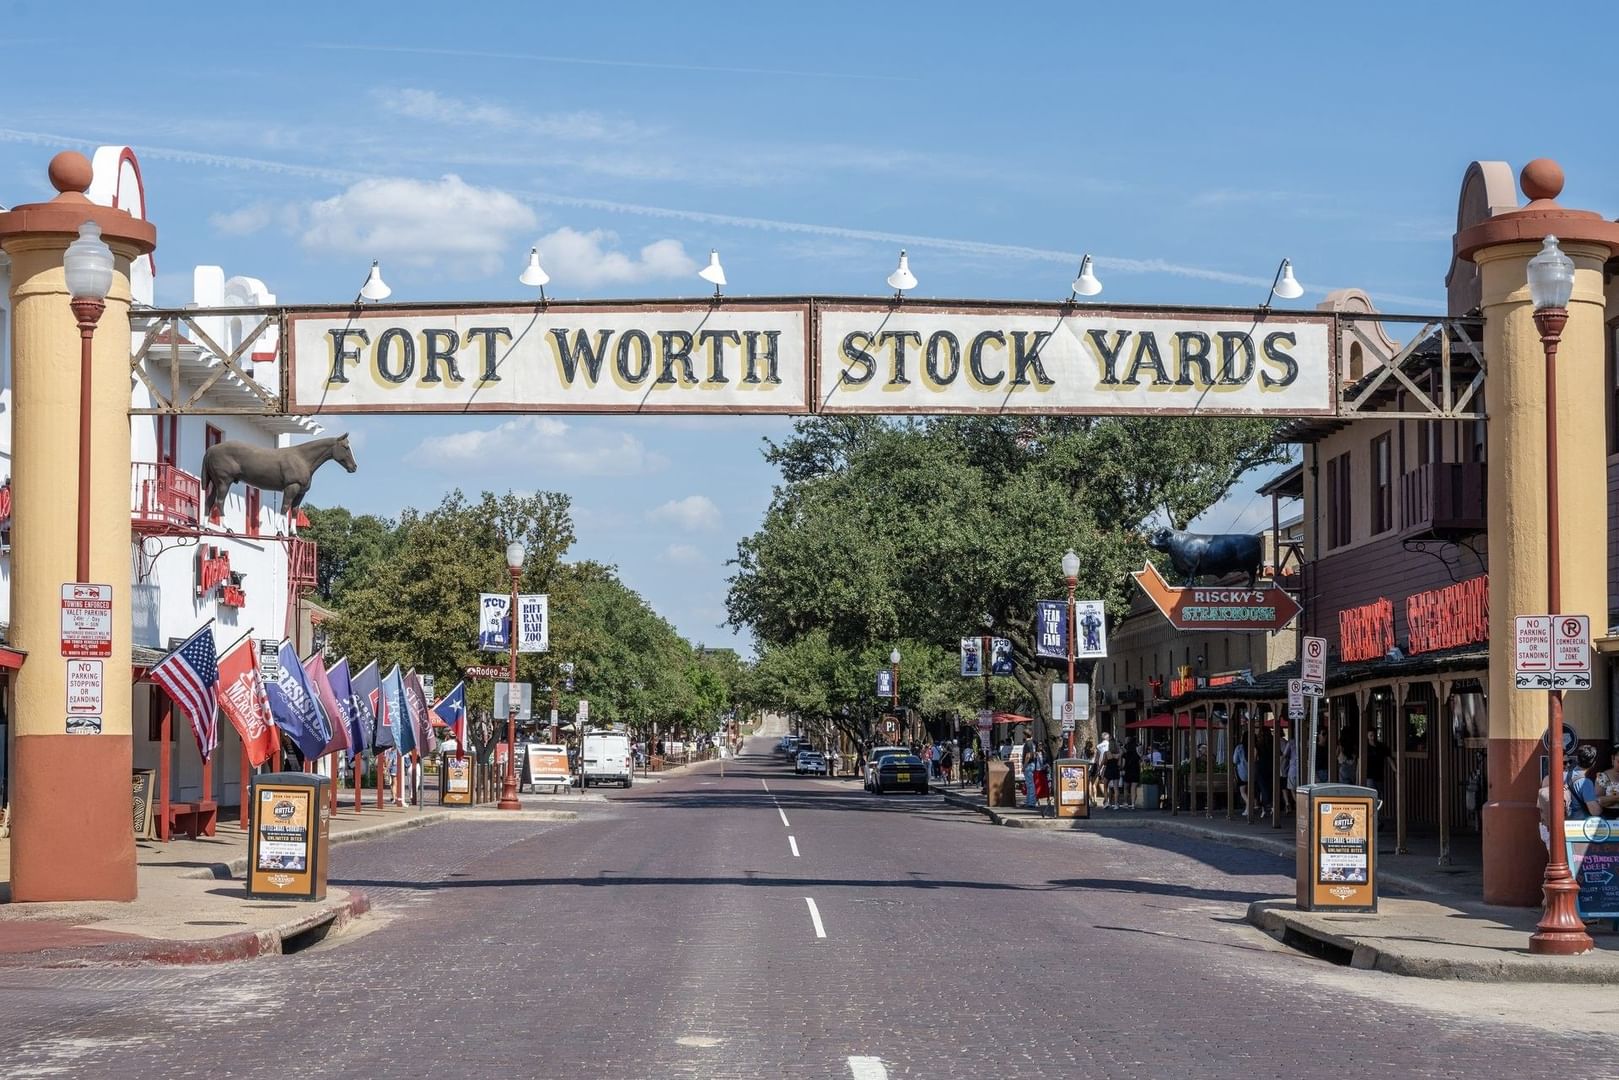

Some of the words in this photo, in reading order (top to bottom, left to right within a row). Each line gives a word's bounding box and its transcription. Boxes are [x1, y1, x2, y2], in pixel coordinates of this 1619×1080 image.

[325, 327, 513, 390] FORT
[547, 328, 783, 391] WORTH
[839, 329, 1056, 392] STOCK
[1086, 329, 1299, 392] YARDS
[1194, 590, 1265, 603] RISCKY'S
[64, 600, 84, 608] TOWING
[84, 601, 110, 609] ENFORCED
[483, 597, 506, 609] TCU
[523, 603, 542, 613] RIFF
[523, 613, 542, 623] RAM
[1181, 606, 1276, 621] STEAKHOUSE
[524, 623, 542, 633] BAH
[1526, 619, 1540, 628] NO
[524, 632, 542, 642] ZOO
[993, 639, 1009, 647] TCU
[78, 663, 91, 672] NO
[476, 666, 499, 676] Rodeo
[225, 679, 266, 739] MERCEDES
